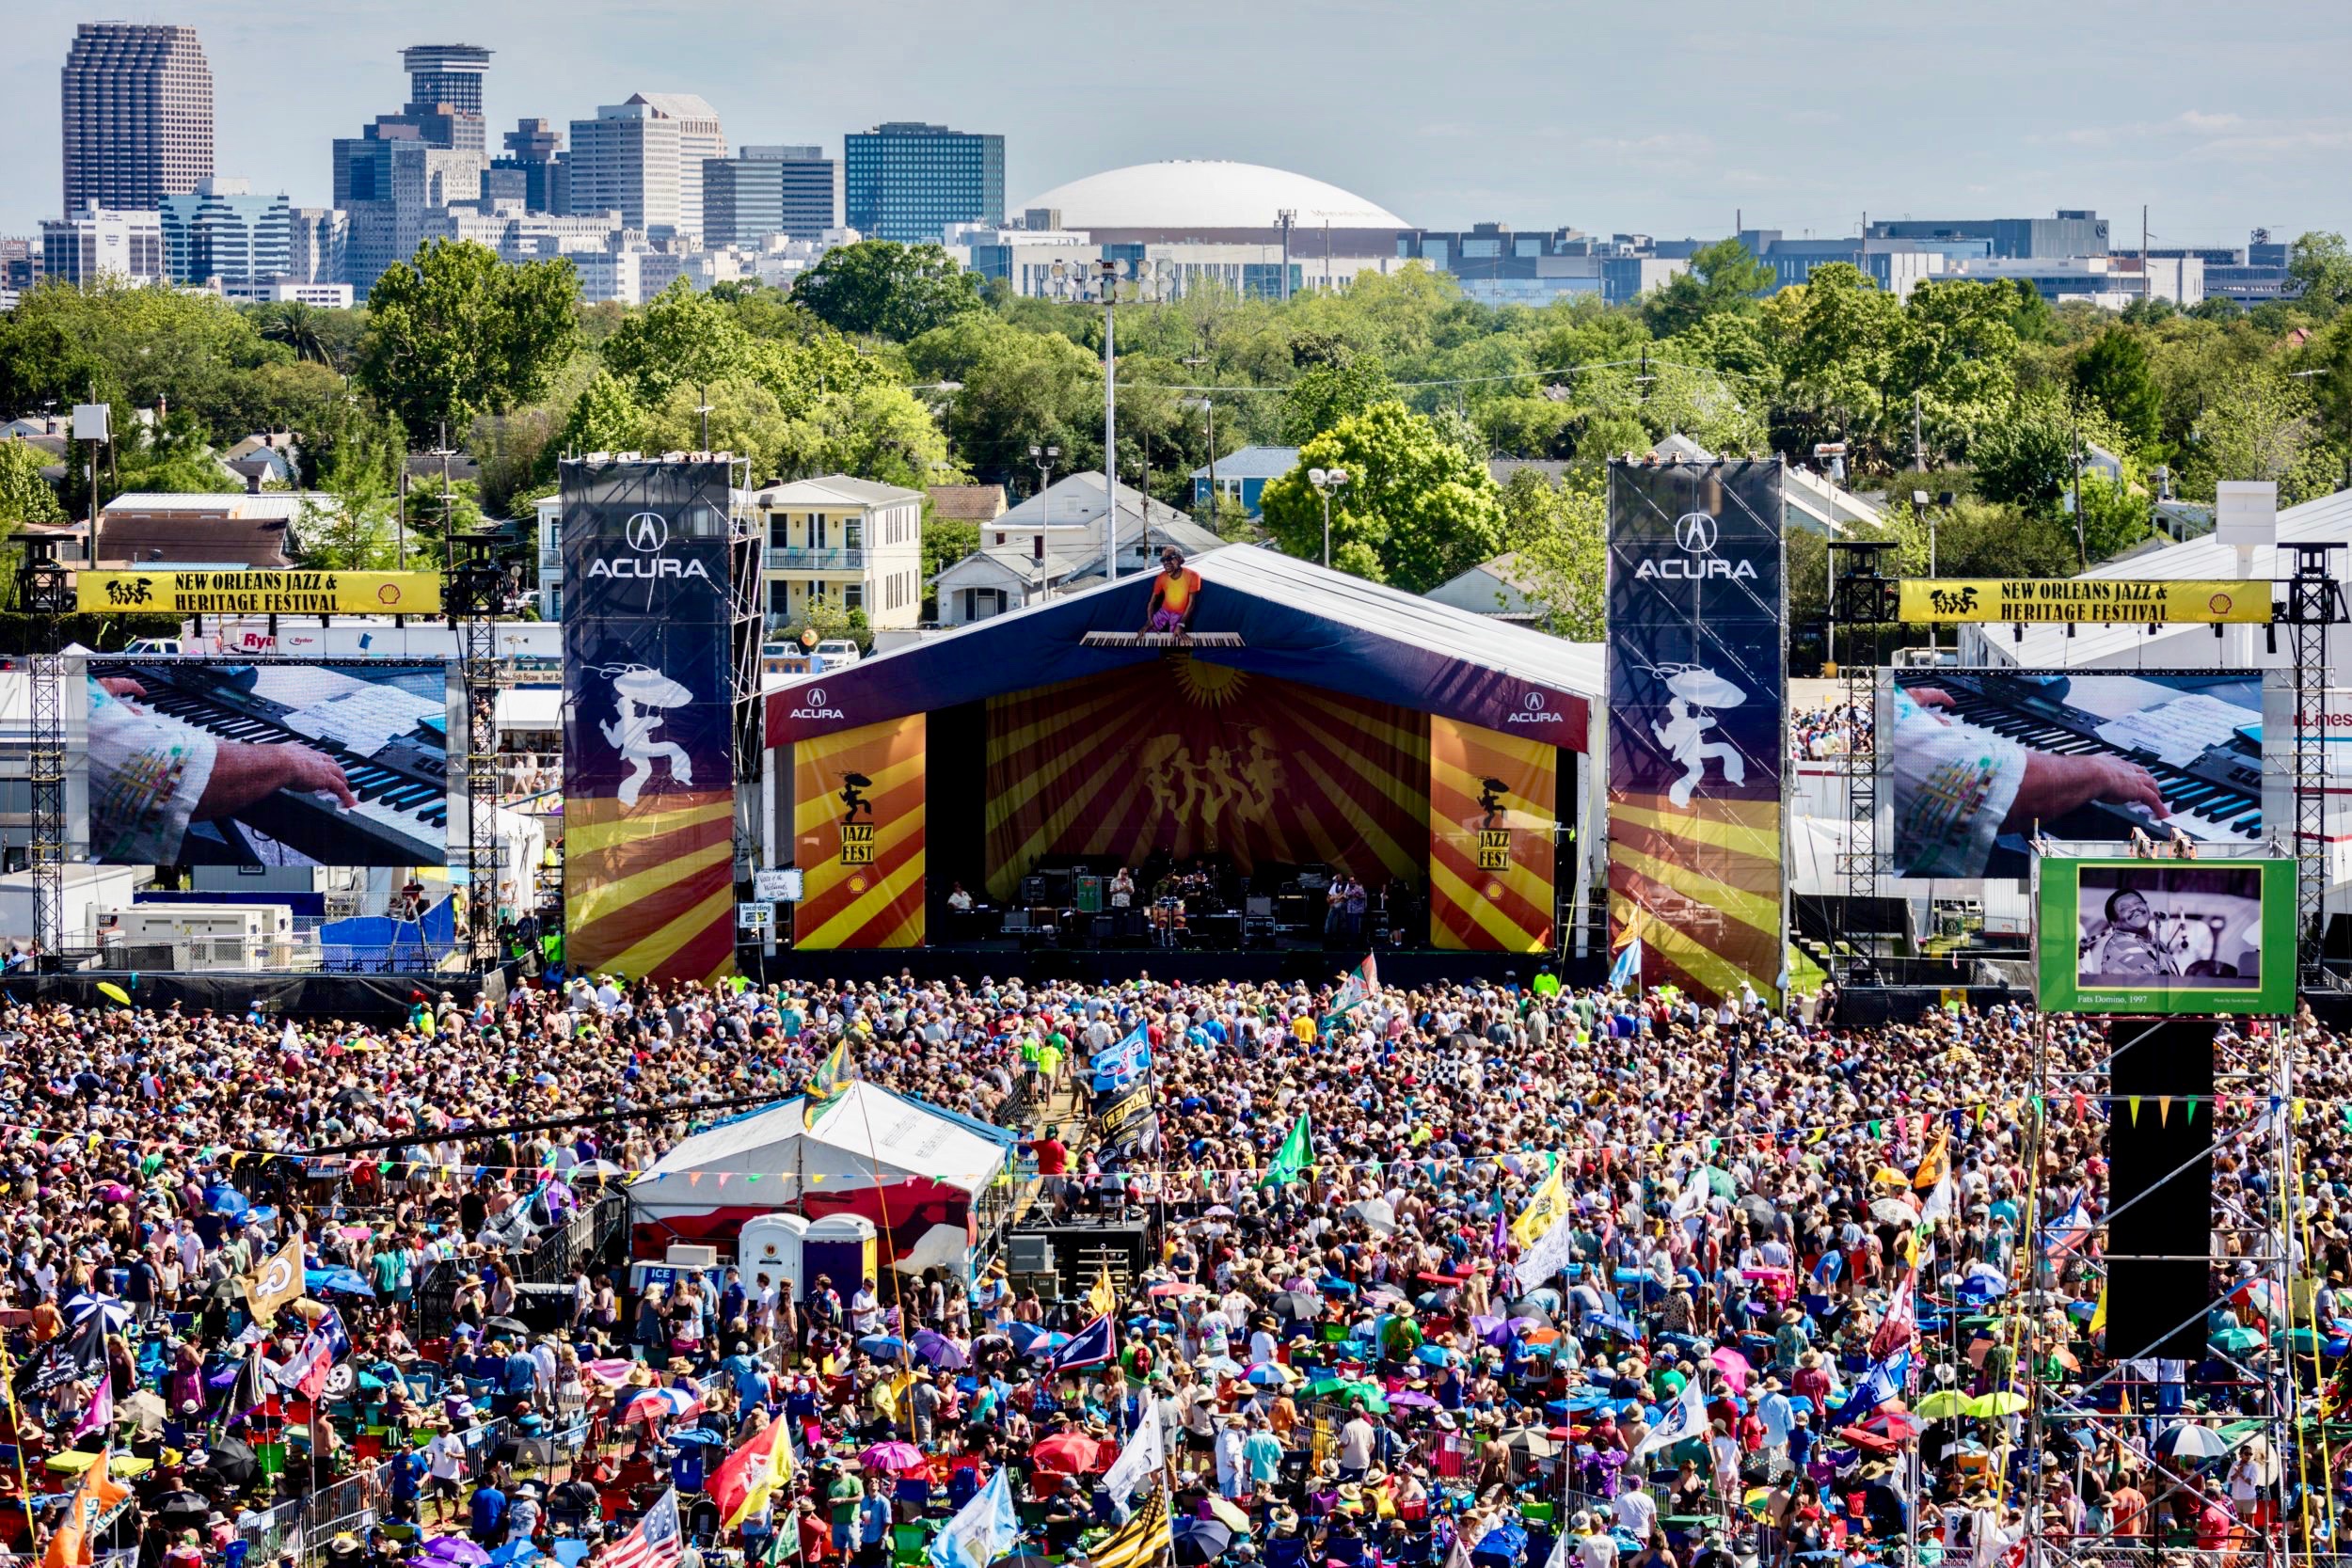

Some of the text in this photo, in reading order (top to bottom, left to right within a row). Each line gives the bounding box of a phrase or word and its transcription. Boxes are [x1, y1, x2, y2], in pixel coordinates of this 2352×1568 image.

[2, 241, 26, 250] Tulane
[587, 558, 709, 578] ACURA
[1634, 559, 1758, 579] ACURA
[175, 573, 338, 593] NEW ORLEANS JAZZ &
[2001, 582, 2168, 602] NEW ORLEANS JAZZ &
[175, 594, 340, 611] HERITAGE FESTIVAL
[2001, 603, 2169, 621] HERITAGE FESTIVAL
[789, 708, 845, 719] ACURA
[1507, 712, 1564, 722] ACURA
[842, 826, 873, 843] JAZZ
[1479, 832, 1509, 848] JAZZ
[842, 846, 873, 861] FEST
[1479, 851, 1510, 866] FEST
[2095, 995, 2127, 1005] Domino,
[2129, 995, 2148, 1004] 1997
[651, 1269, 671, 1278] ICE
